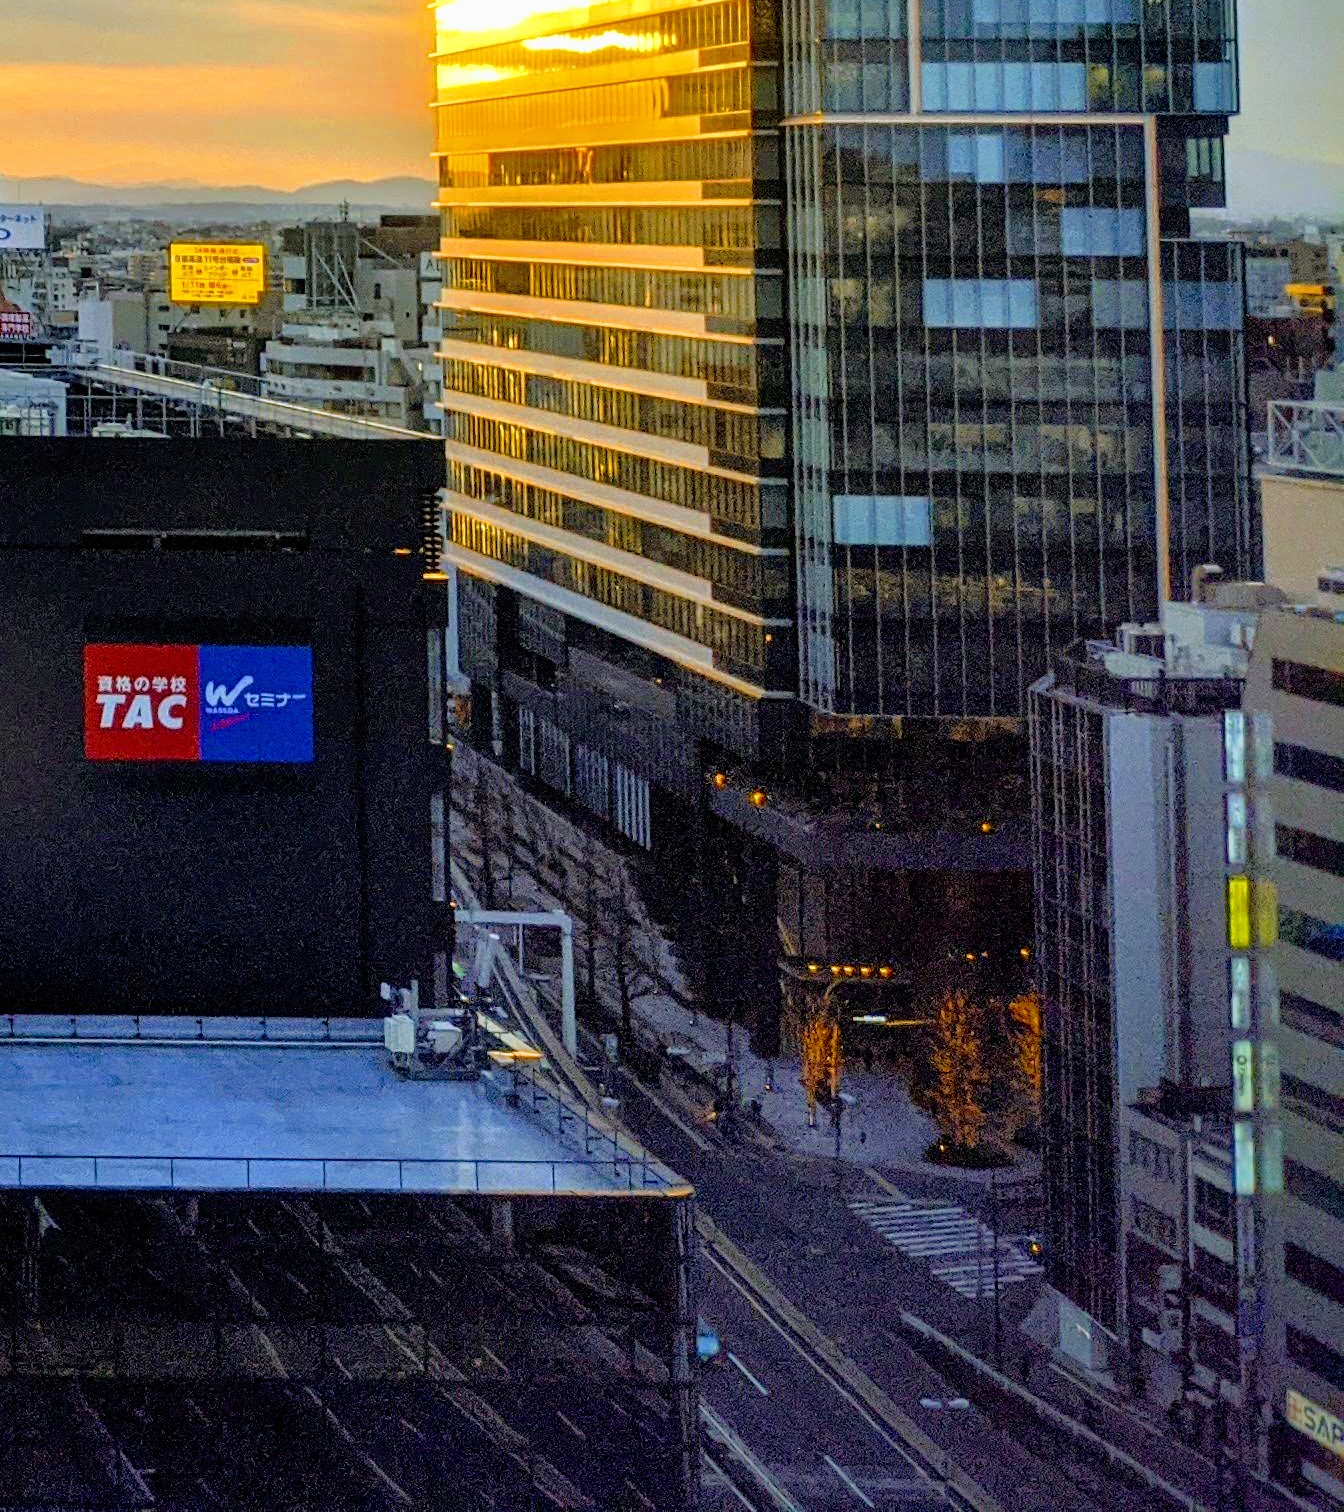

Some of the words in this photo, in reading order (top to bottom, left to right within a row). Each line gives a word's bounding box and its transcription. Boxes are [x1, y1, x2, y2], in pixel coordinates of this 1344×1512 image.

[97, 675, 187, 693] 資格の学校
[244, 692, 307, 707] セミナー
[96, 694, 188, 729] TAC
